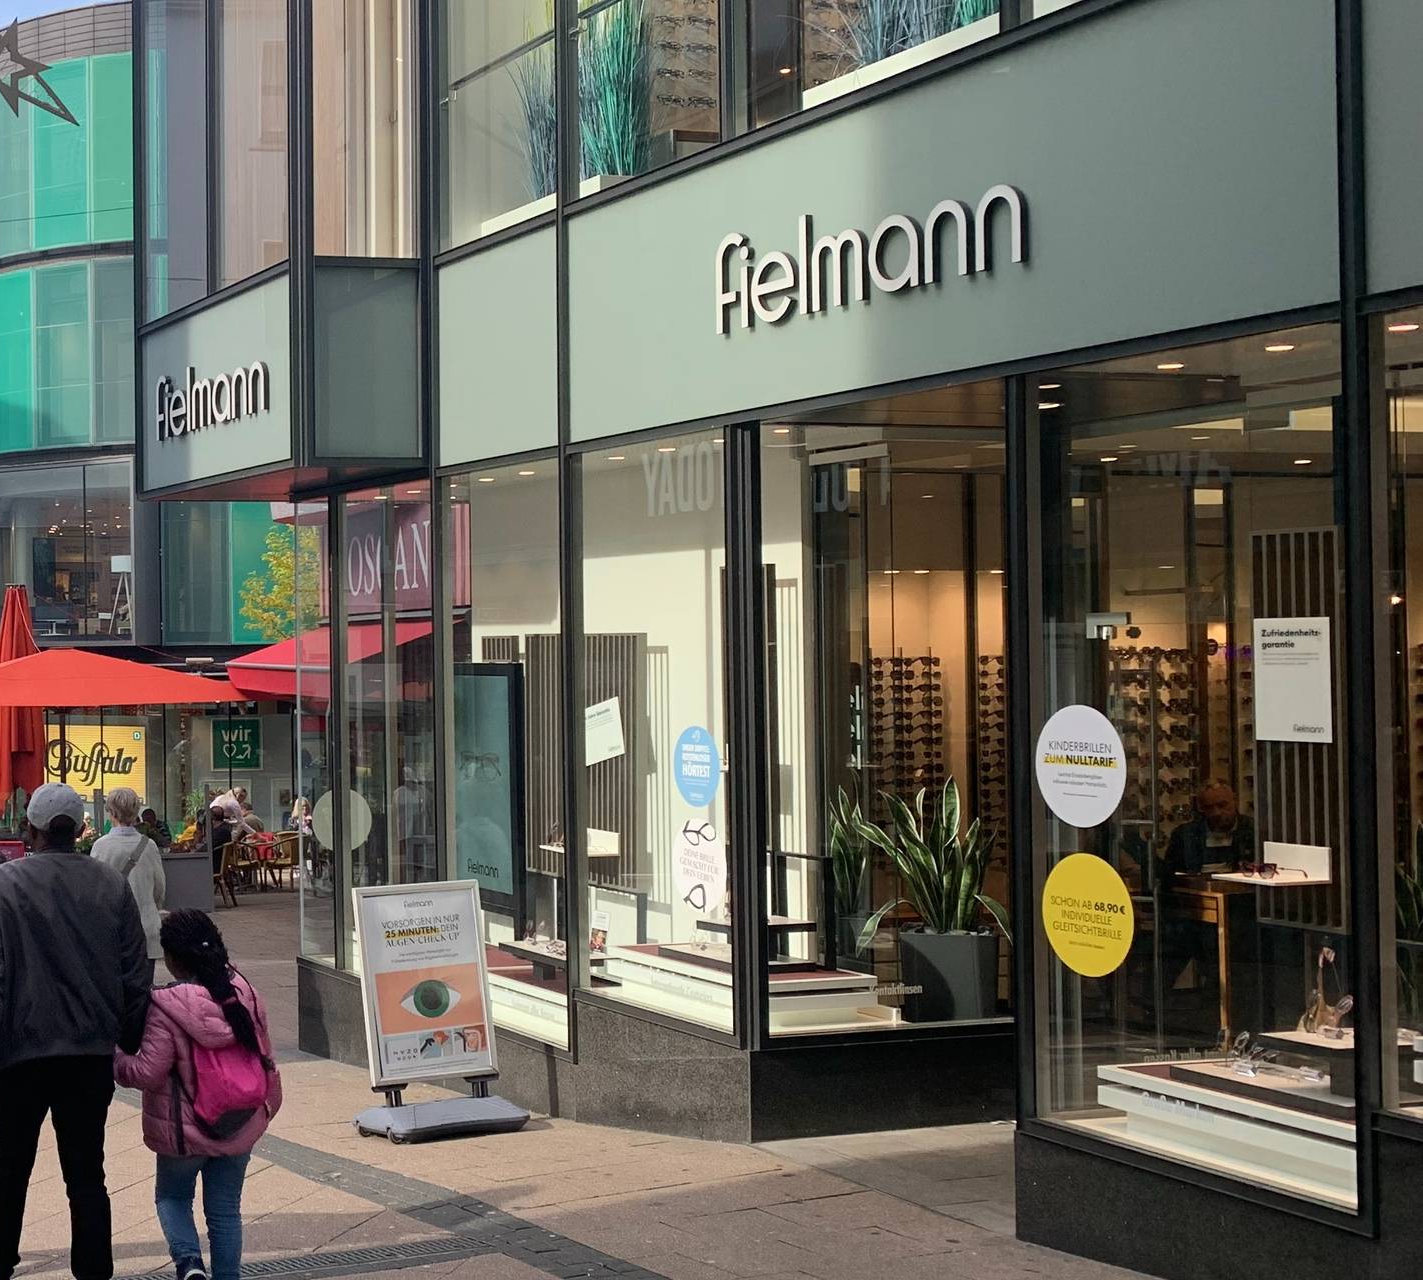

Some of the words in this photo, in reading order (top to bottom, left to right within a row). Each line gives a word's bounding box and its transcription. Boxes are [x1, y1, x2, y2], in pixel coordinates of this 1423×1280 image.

[715, 184, 1024, 336] fielmann
[156, 360, 269, 442] fielmann
[1261, 629, 1321, 638] Zufriedenheits-
[1261, 641, 1295, 650] garantie
[221, 726, 252, 742] wir
[1048, 741, 1112, 754] KINDERBRILLEN
[45, 738, 138, 787] Buffalo
[1044, 753, 1065, 764] ZUM
[1050, 895, 1080, 908] SCHON
[1082, 900, 1093, 910] AB
[381, 916, 432, 929] VORSORGEN
[433, 915, 442, 924] IN
[443, 913, 460, 923] NUR
[1061, 909, 1113, 926] INDIVIDUELLE
[385, 929, 396, 938] 25
[397, 925, 440, 938] MINUTEN:
[440, 923, 459, 932] DEIN
[1052, 920, 1122, 940] GLEITSICHTBRILLE
[869, 982, 923, 996] Kontaktlinsen
